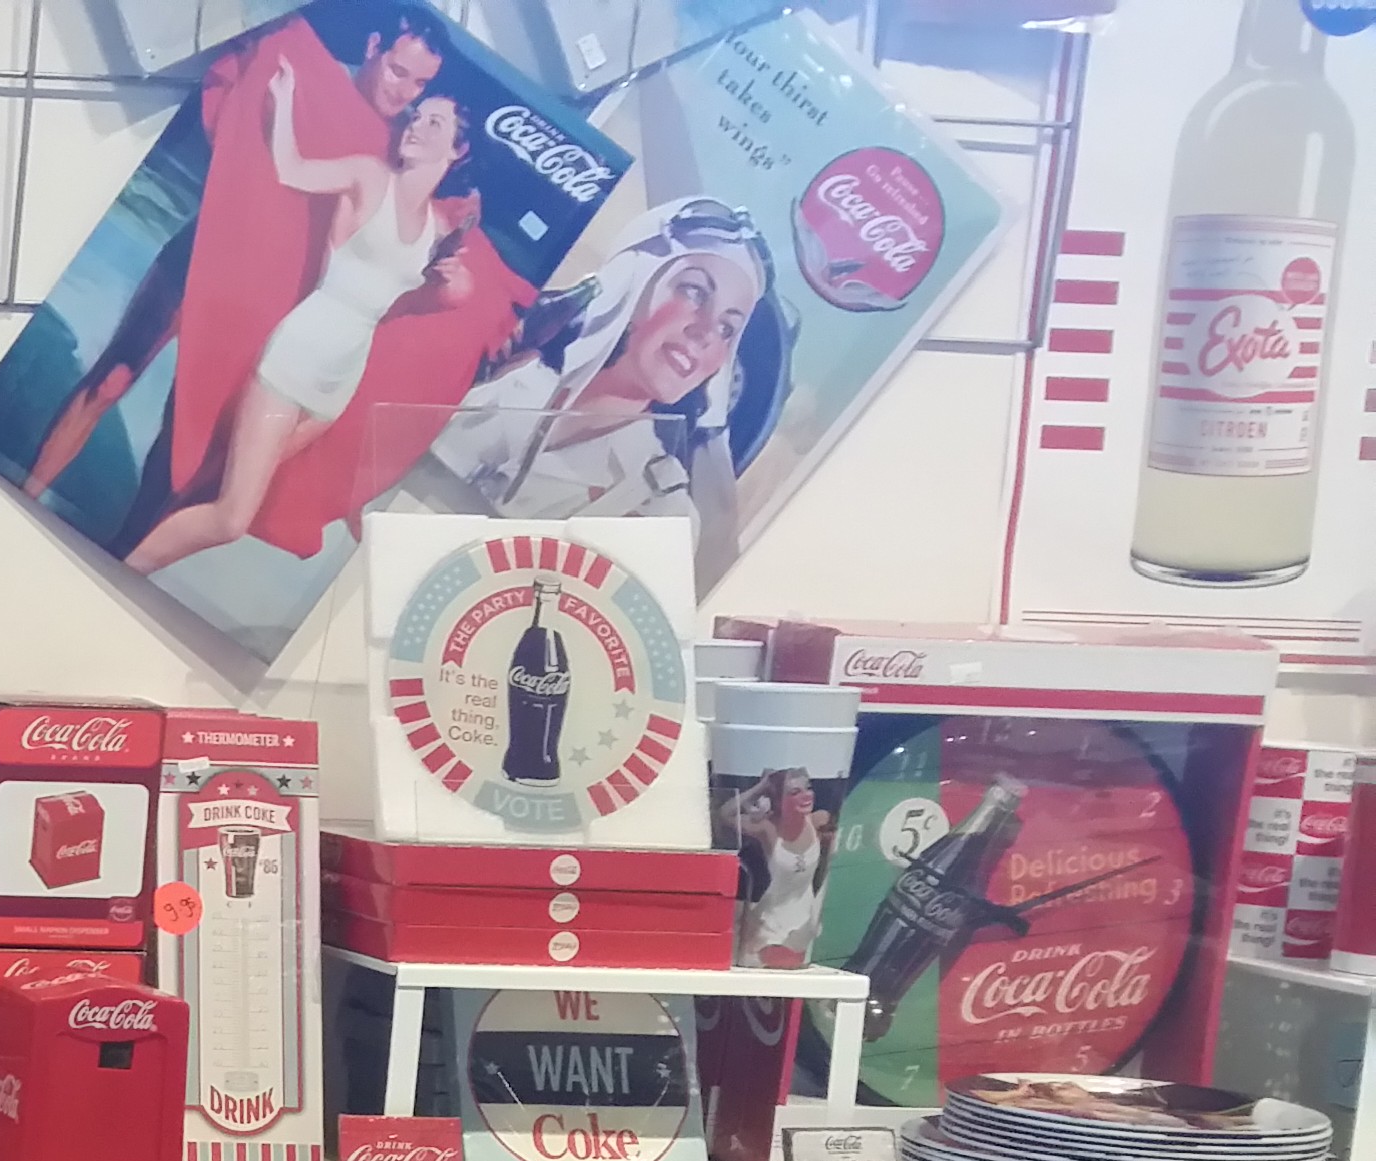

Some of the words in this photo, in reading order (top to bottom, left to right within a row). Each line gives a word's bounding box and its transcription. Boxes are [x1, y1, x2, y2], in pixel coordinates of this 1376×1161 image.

[718, 69, 771, 124] takes
[772, 71, 828, 126] thirst
[484, 105, 615, 203] Coca-Cola
[818, 174, 930, 272] Coca-Cola
[1198, 305, 1290, 378] Exota
[448, 619, 476, 653] THE
[473, 589, 527, 626] PARTY
[564, 596, 631, 679] FAVORITE
[439, 668, 467, 686] It's
[471, 672, 499, 690] the
[508, 665, 571, 695] Coca-Cola
[844, 648, 926, 680] Coca-Cola
[464, 692, 497, 708] real
[21, 715, 129, 754] Coca-Cola
[197, 731, 279, 748] THERMOMETER
[447, 726, 499, 747] Coke.
[203, 804, 240, 823] DRINK
[244, 805, 276, 824] COKE
[492, 789, 566, 821] VOTE
[56, 839, 97, 860] Coca-Cola
[1010, 849, 1140, 880] Delicious
[1012, 944, 1082, 963] DRINK
[961, 946, 1158, 1025] Coca-Cola
[68, 998, 156, 1031] Coca-Cola
[554, 990, 600, 1021] WE
[1028, 1015, 1128, 1040] BOTTLES
[528, 1045, 634, 1095] WANT
[210, 1084, 275, 1126] DRINK
[375, 1141, 412, 1150] DRINK
